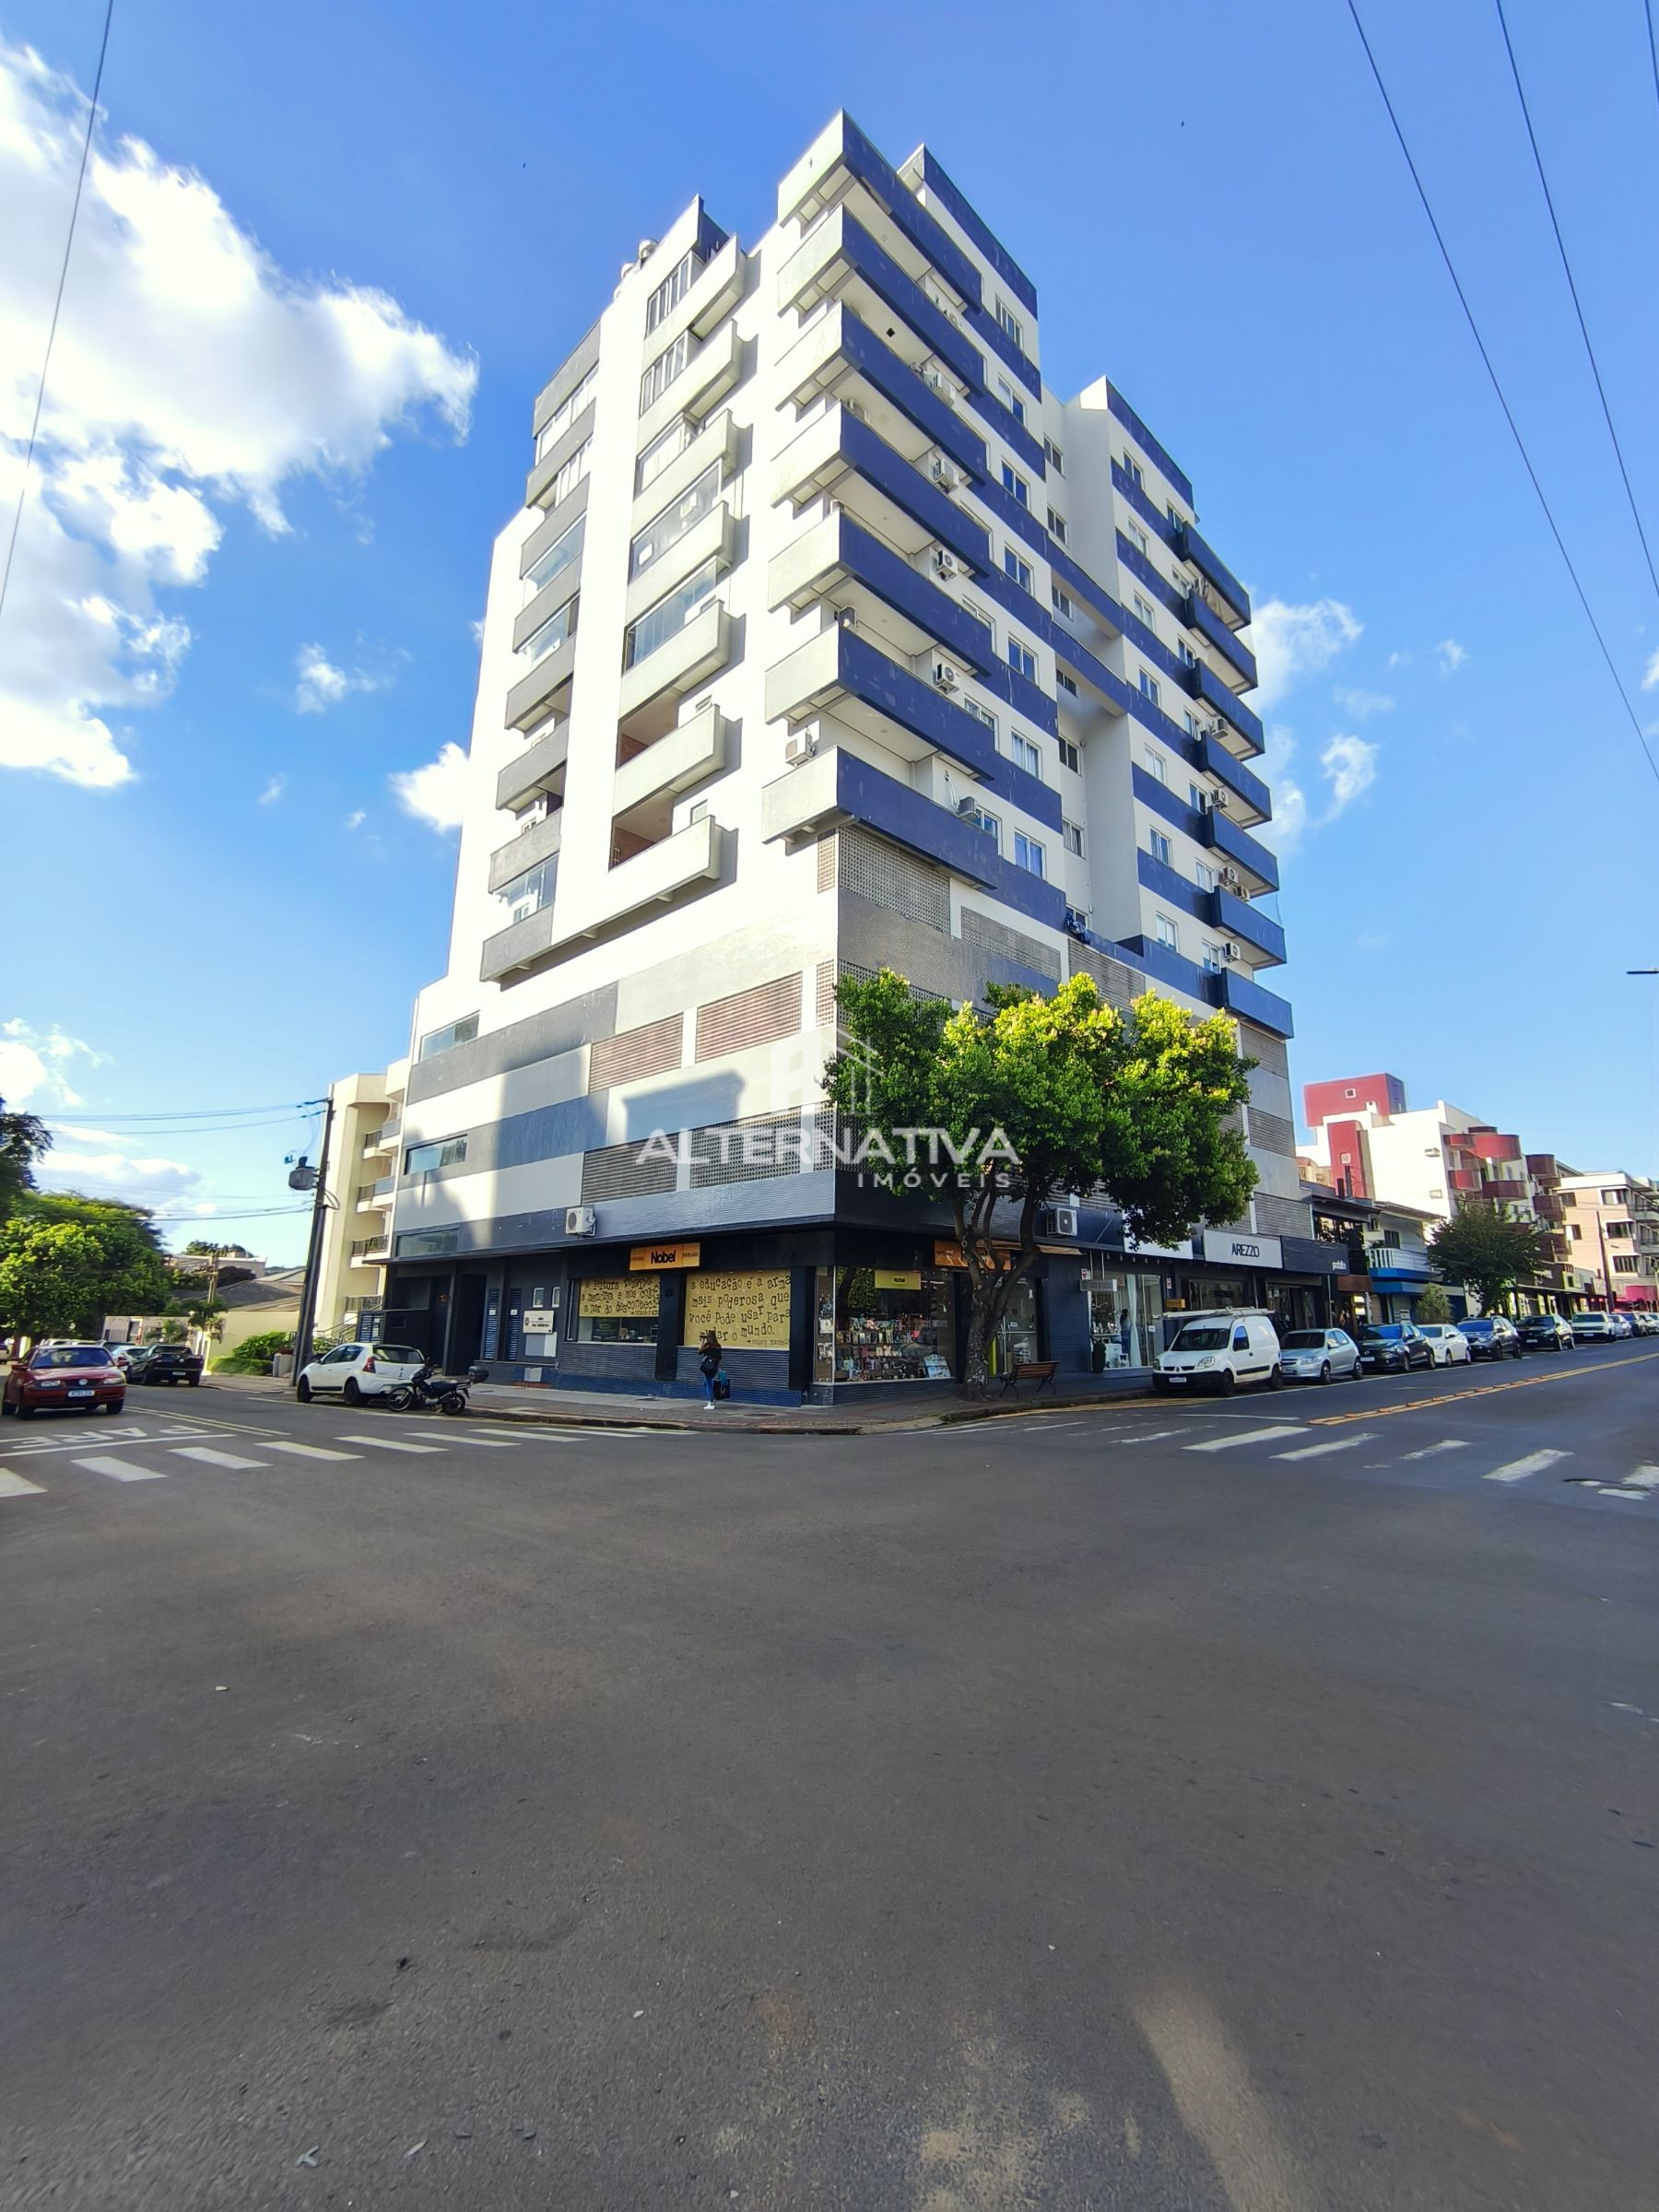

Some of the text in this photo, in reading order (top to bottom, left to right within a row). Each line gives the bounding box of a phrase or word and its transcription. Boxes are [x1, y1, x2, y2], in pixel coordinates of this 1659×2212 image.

[650, 1250, 677, 1265] Nobel
[1231, 1243, 1260, 1257] AREZZO
[691, 1275, 791, 1291] a educação é a arma
[691, 1291, 790, 1310] mais poderosa que
[688, 1304, 791, 1325] você pode usar para
[731, 1332, 737, 1342] o
[740, 1323, 775, 1338] mundo.
[0, 1425, 210, 1450] PARE
